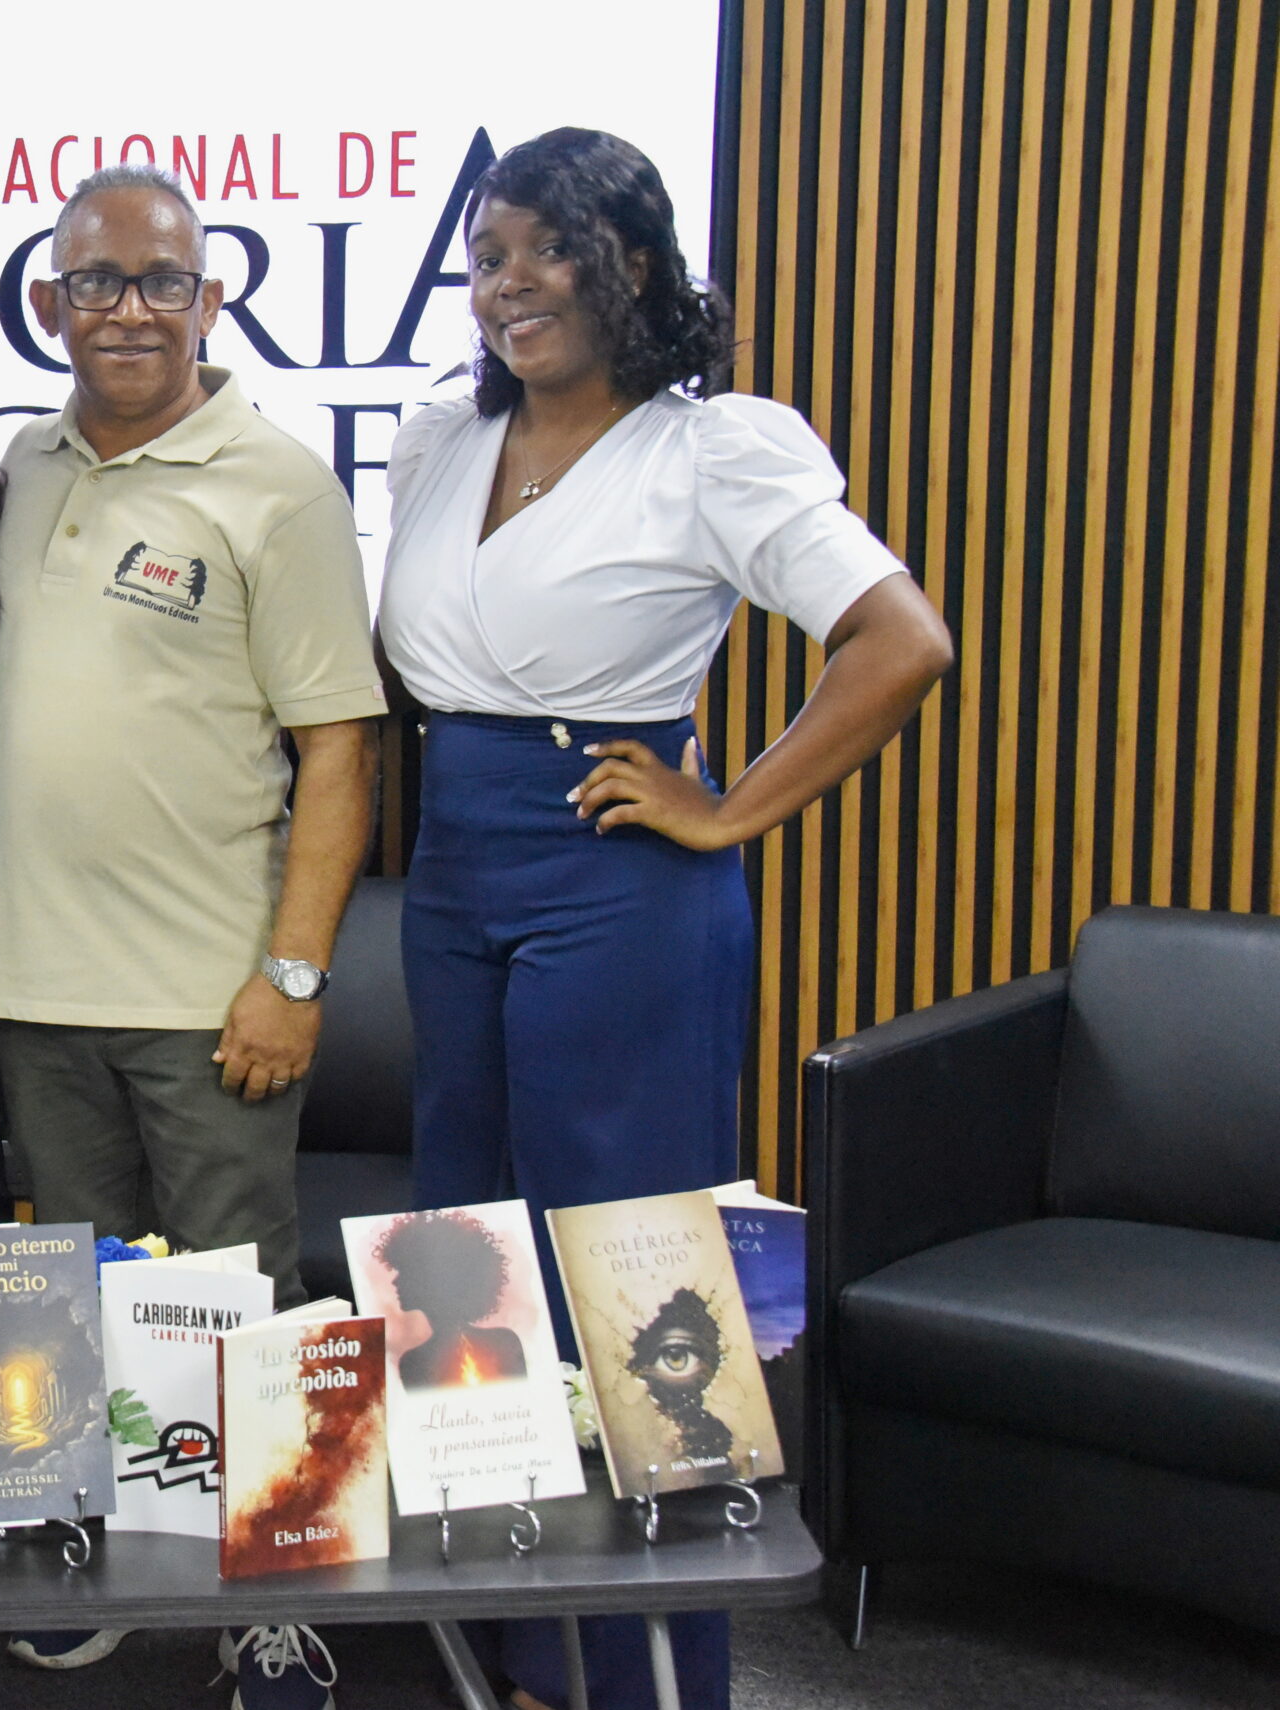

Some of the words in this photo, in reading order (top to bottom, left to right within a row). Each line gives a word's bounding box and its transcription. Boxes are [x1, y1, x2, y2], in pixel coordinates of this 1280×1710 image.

[339, 130, 417, 199] DE
[142, 561, 180, 587] UME
[128, 592, 168, 615] Monstruos
[167, 606, 200, 624] Editores
[11, 1238, 75, 1256] eterno
[0, 1258, 19, 1272] mi
[611, 1256, 647, 1273] DEL
[654, 1249, 689, 1267] OJO
[133, 1302, 207, 1329] CARIBBEAN
[211, 1308, 242, 1331] WAY
[288, 1336, 362, 1362] erosión
[258, 1366, 359, 1405] aprendida
[420, 1402, 484, 1431] Llanto,
[492, 1405, 532, 1423] savia
[429, 1445, 438, 1462] y
[443, 1425, 539, 1461] pensamiento
[15, 1473, 62, 1486] GISSEL
[274, 1529, 303, 1547] Elsa
[306, 1525, 340, 1542] Báez
